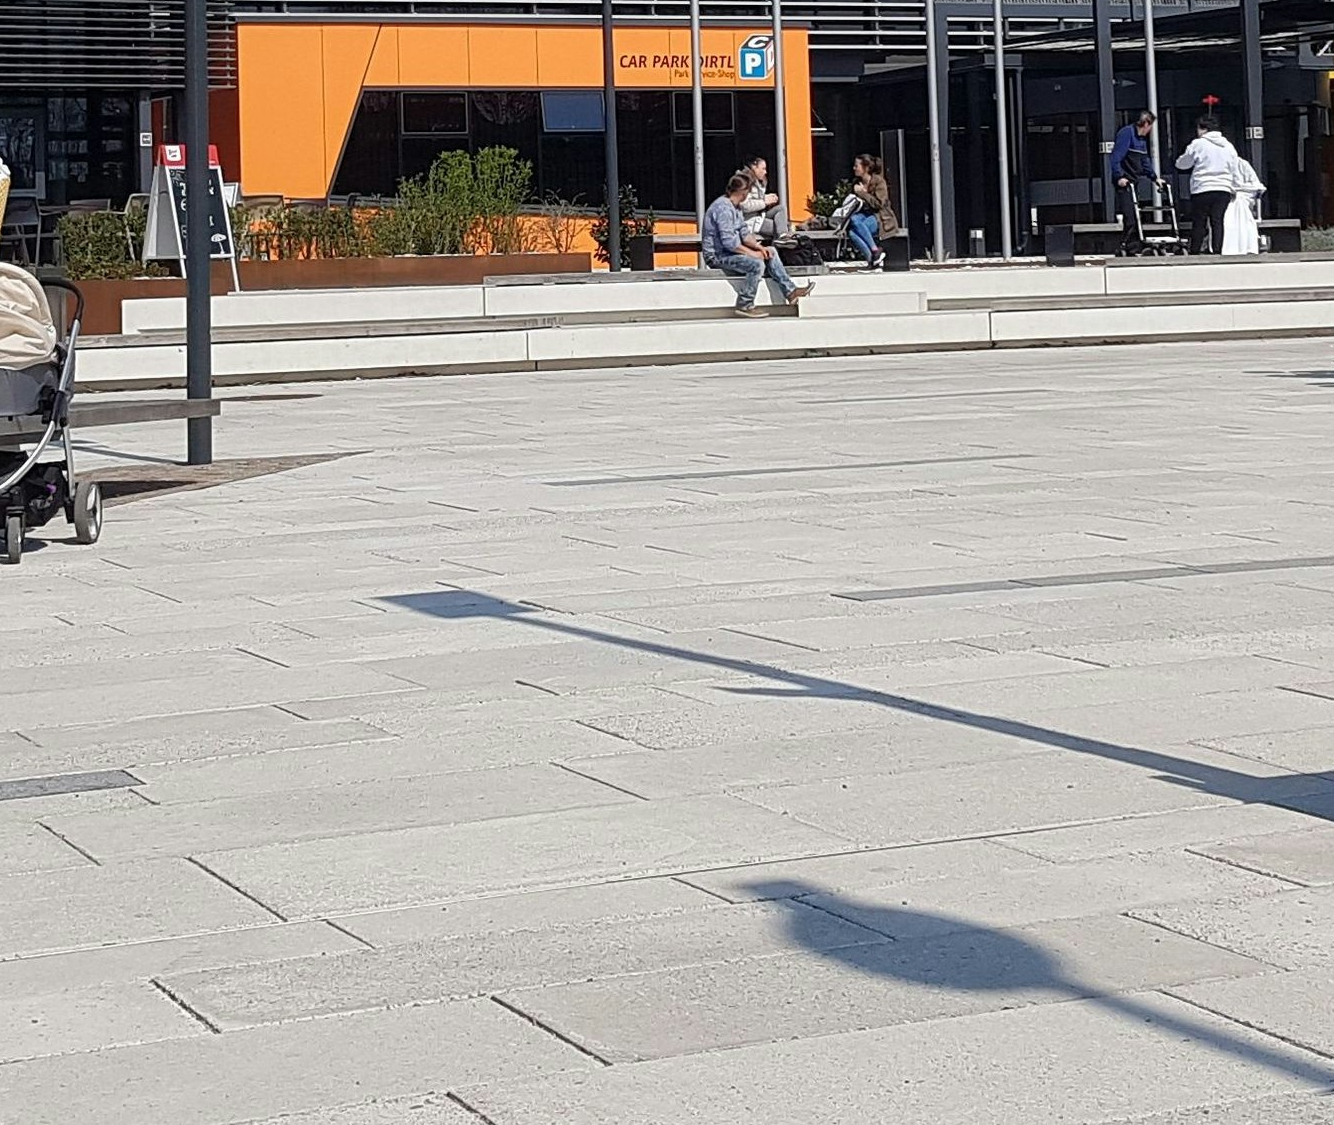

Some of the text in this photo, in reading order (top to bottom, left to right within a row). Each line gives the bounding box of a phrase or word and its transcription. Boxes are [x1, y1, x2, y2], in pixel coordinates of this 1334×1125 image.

[619, 55, 647, 68] CAR
[653, 55, 690, 68] PARK
[745, 53, 762, 74] P
